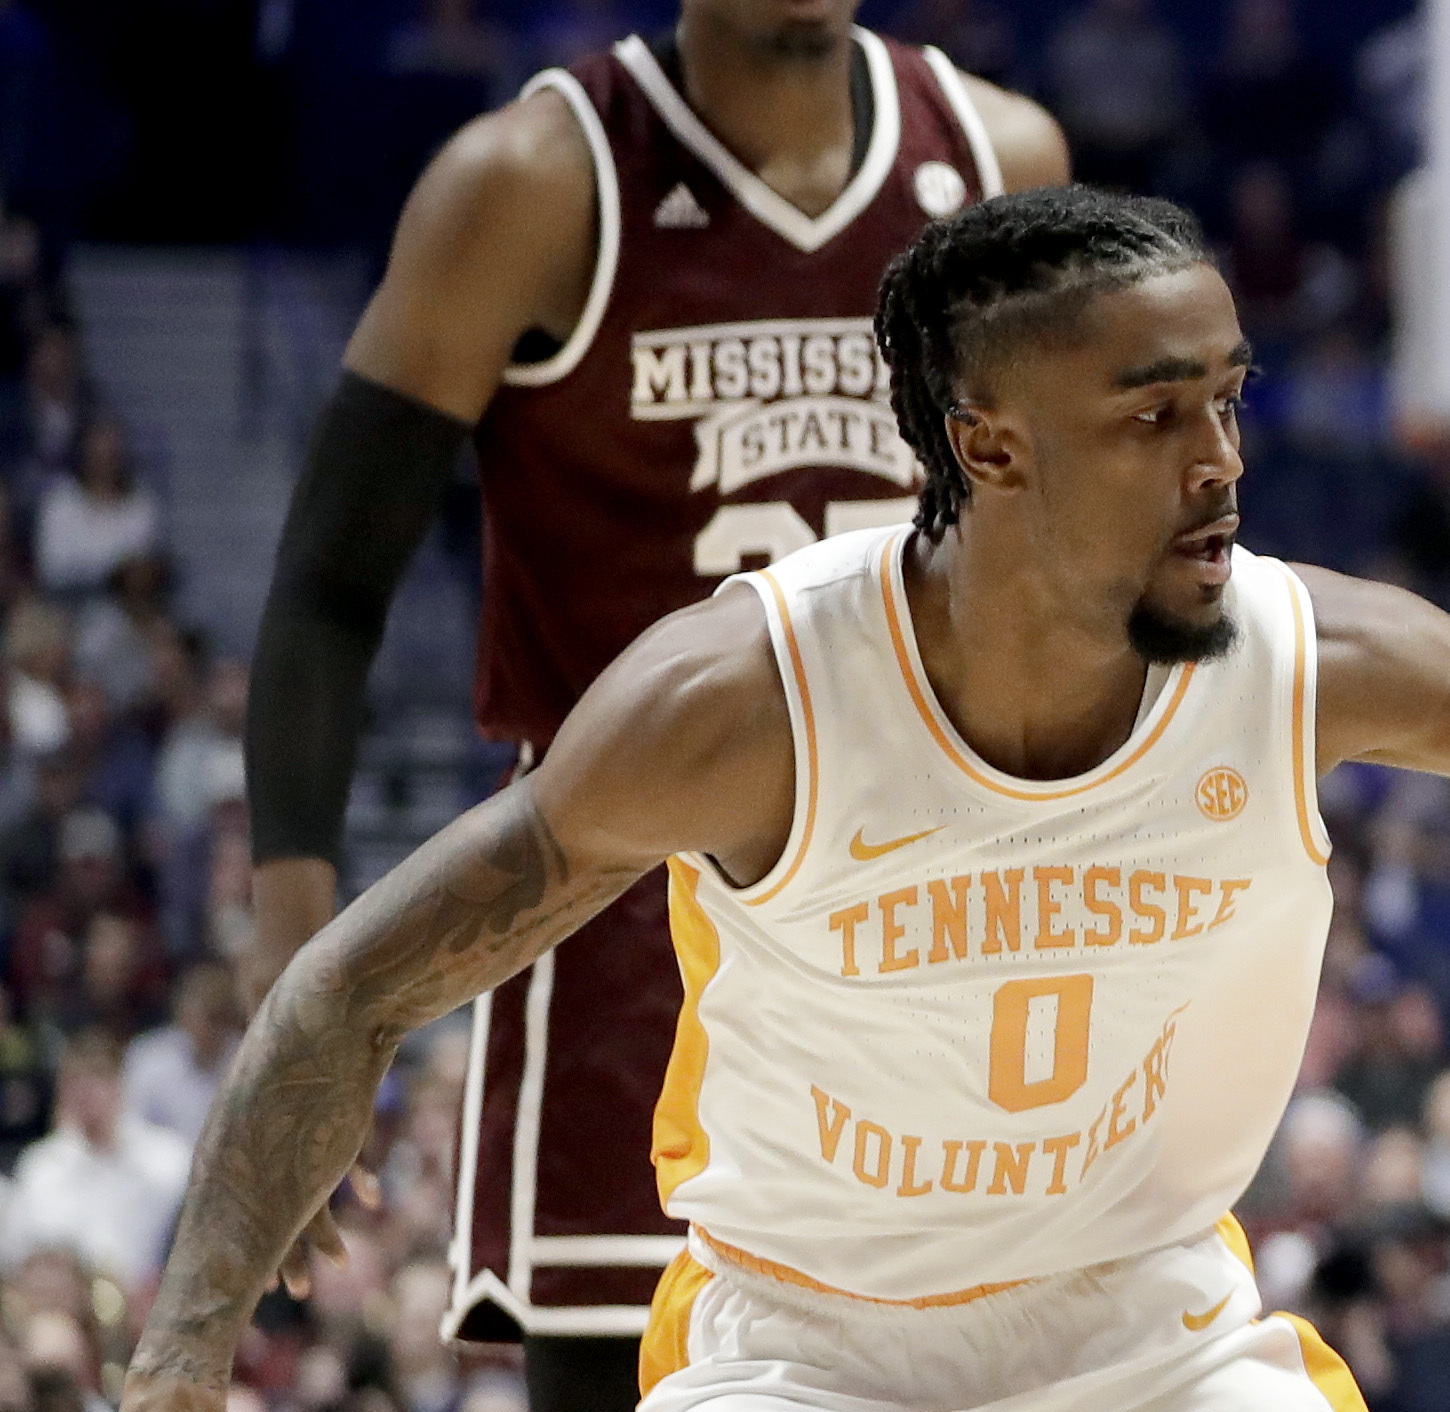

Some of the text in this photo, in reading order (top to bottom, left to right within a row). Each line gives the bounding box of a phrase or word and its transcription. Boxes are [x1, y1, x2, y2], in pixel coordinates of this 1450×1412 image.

[740, 411, 897, 466] STATE
[1198, 771, 1244, 817] SEC
[828, 866, 1253, 978] TENNESSEE
[987, 973, 1095, 1115] 0
